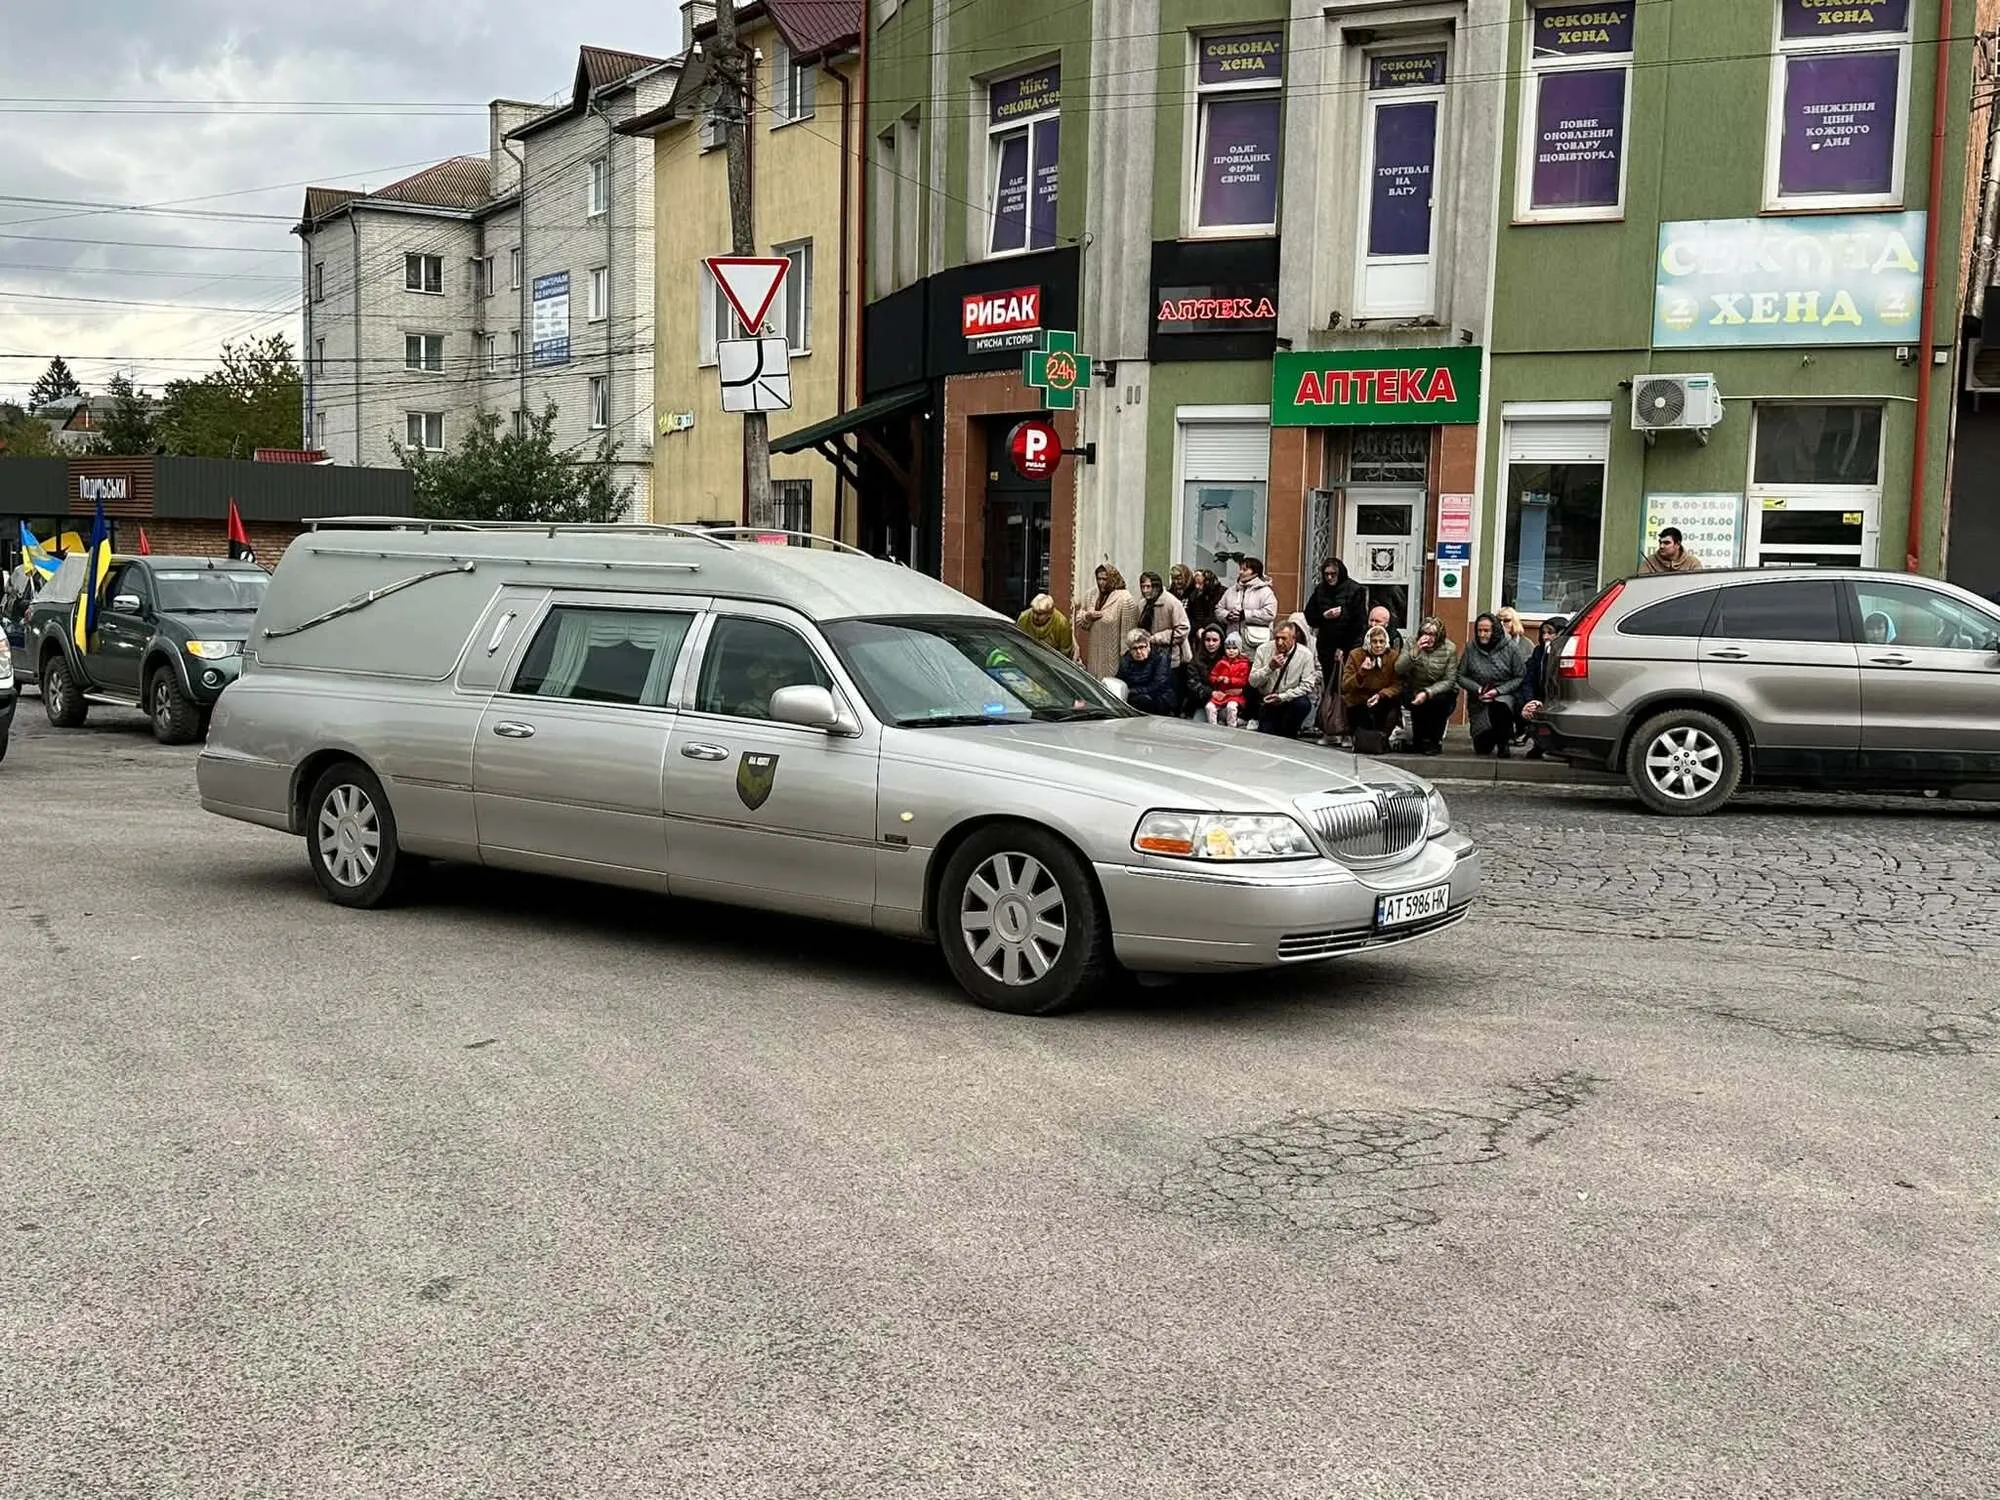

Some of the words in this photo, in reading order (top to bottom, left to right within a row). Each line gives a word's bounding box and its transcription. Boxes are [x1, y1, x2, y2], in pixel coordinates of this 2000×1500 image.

[1803, 102, 1876, 114] ЗНИЖЕННЯ
[1560, 119, 1599, 129] ПОВНЕ
[1543, 129, 1614, 141] ОНОВЛЕННЯ
[1806, 125, 1870, 136] КОЖНОГО
[1555, 140, 1600, 151] ТОВАРУ
[1823, 137, 1850, 147] ДНЯ
[1229, 145, 1257, 153] ОДЯГ
[1539, 150, 1616, 163] ЩОВІВТОРКА
[1228, 164, 1254, 173] ФІРМ
[1378, 165, 1430, 176] ТОРГІВЛЯ
[1396, 177, 1410, 185] НА
[1388, 187, 1417, 196] ВАГУ
[1661, 231, 1920, 277] СЕКОНД
[965, 294, 1036, 329] РИБАК
[1158, 298, 1276, 320] АПТЕКА
[1709, 290, 1863, 327] ХЕНД
[1005, 333, 1034, 346] ІСТОРІЯ
[1047, 359, 1075, 381] 24h
[1293, 367, 1458, 405] АПТЕКА
[1650, 499, 1666, 509] Вт
[1648, 515, 1665, 527] Ср
[1386, 899, 1404, 922] AT
[1405, 892, 1431, 917] 5986
[1432, 888, 1447, 912] HK
